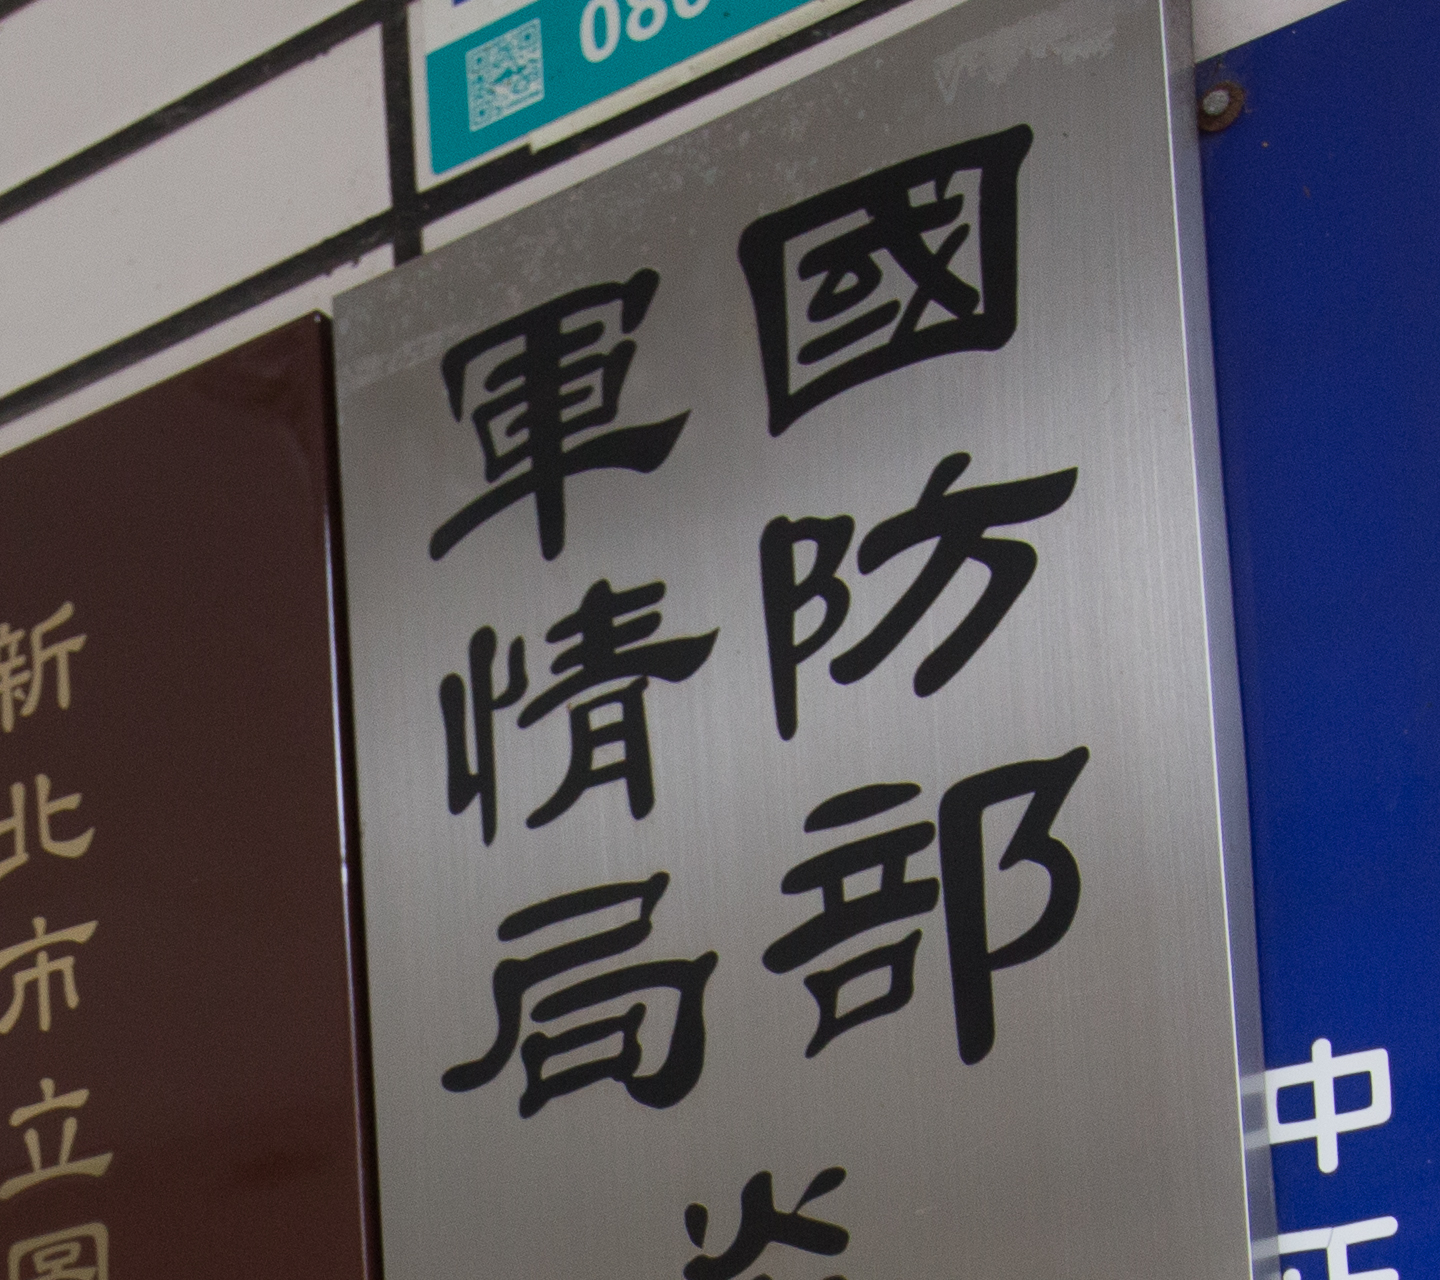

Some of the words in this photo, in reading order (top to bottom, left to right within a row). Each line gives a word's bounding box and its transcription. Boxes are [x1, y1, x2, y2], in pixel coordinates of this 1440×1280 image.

[427, 265, 719, 1119] 軍情局
[737, 122, 1091, 1066] 國防部
